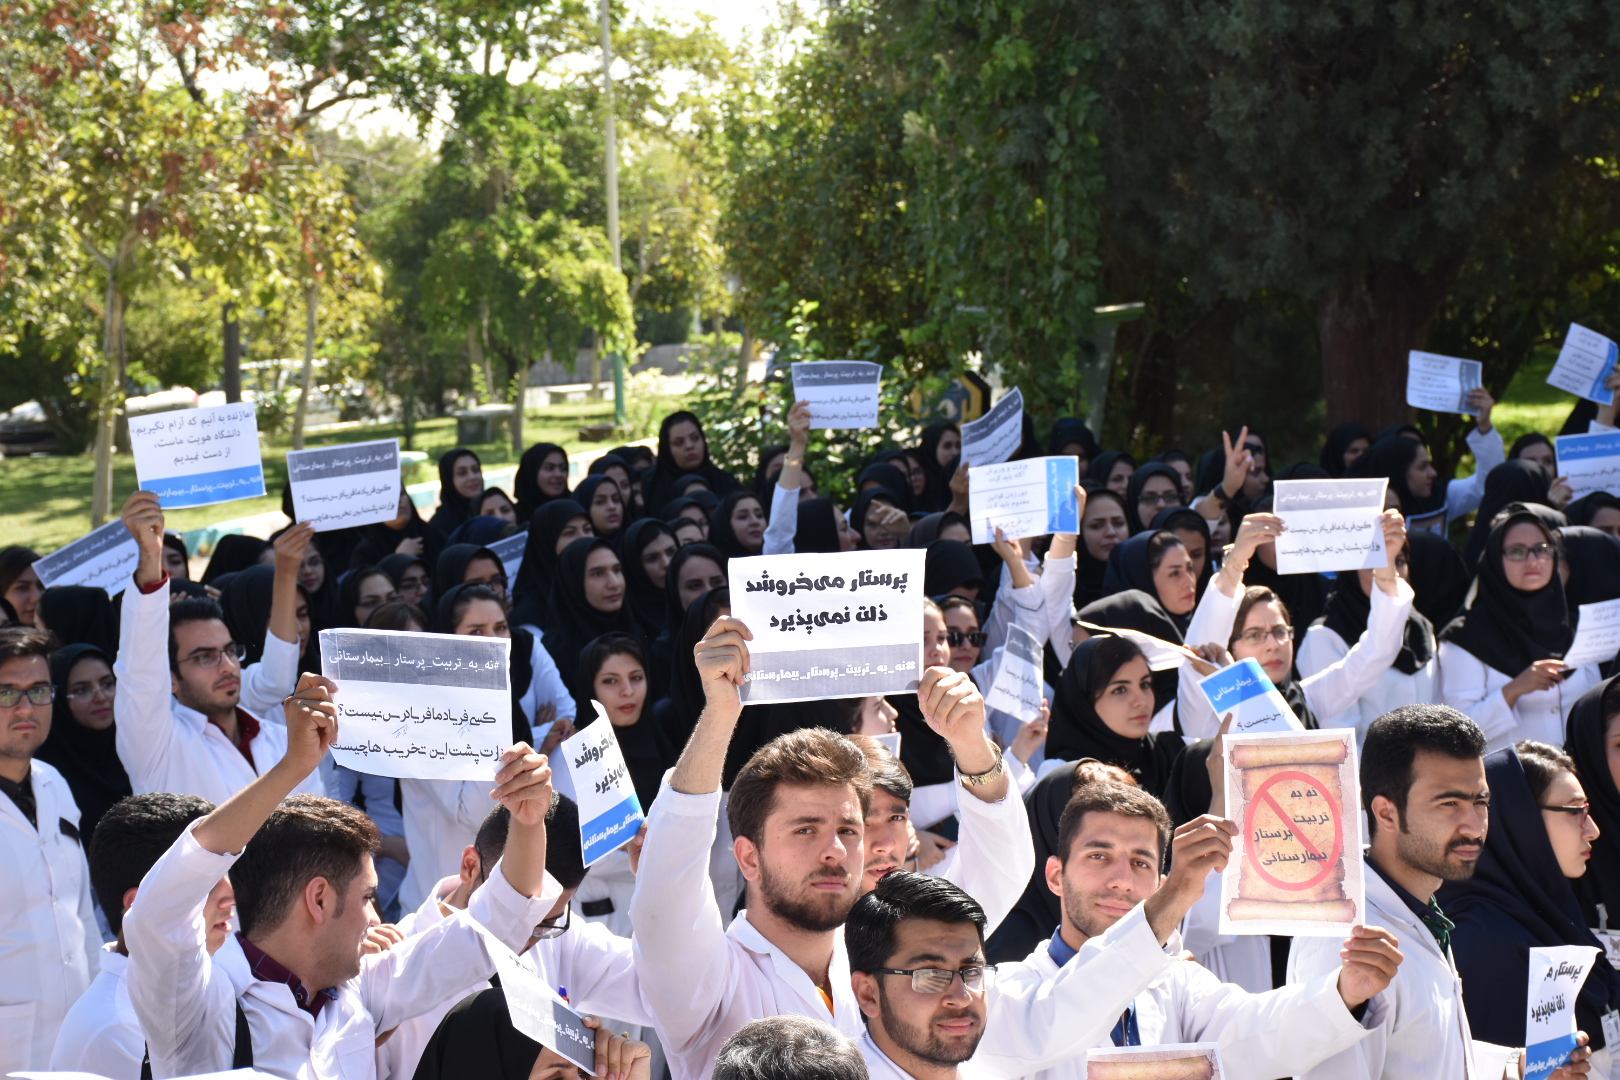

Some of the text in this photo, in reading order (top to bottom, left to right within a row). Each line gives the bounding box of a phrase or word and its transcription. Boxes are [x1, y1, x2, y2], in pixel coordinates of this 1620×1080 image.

[187, 434, 212, 446] هویت
[215, 429, 240, 440] دانشگاه
[202, 450, 222, 459] دست
[849, 569, 908, 593] پرستار
[855, 604, 888, 622] ذلت
[1290, 787, 1318, 800] نه به
[1292, 811, 1330, 825] تربیت
[1253, 828, 1294, 842] پرستار
[1262, 850, 1328, 866] بیمارستانی
[1553, 961, 1583, 983] پرستار
